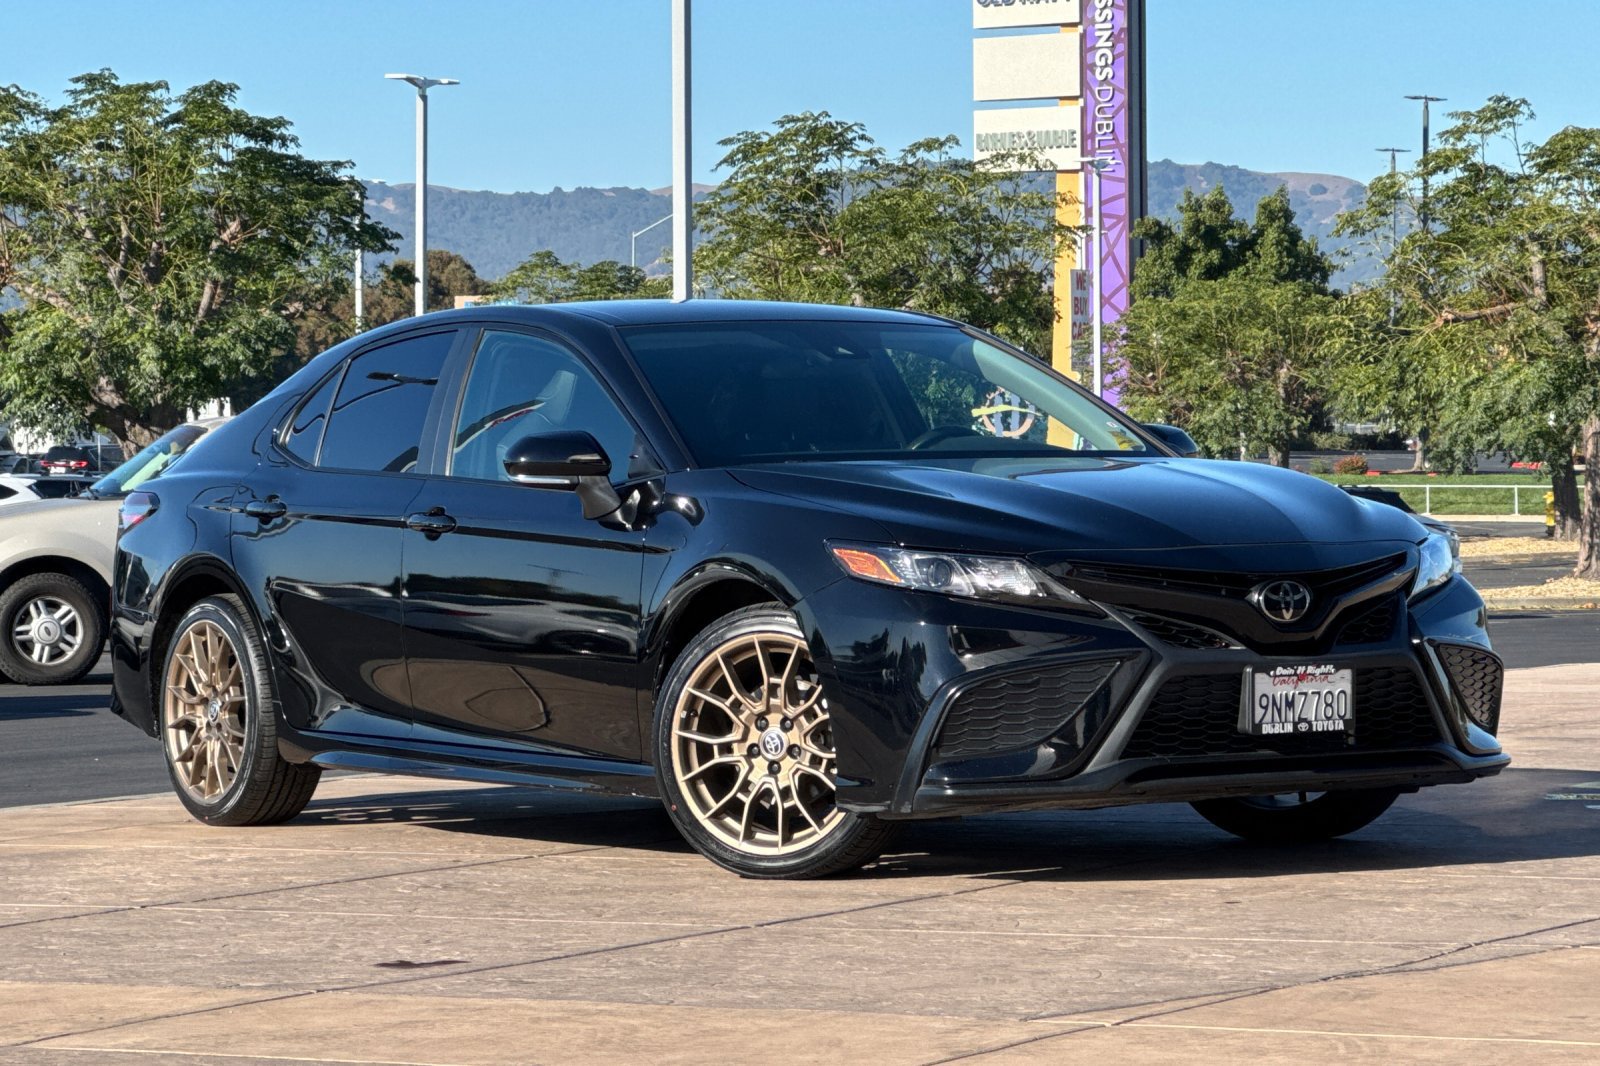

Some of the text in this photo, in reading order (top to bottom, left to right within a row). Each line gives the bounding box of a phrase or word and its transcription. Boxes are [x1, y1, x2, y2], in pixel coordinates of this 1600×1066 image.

[1095, 86, 1114, 173] DUBLIN
[1074, 297, 1088, 315] BUY
[1272, 675, 1328, 689] Califrnia
[1258, 689, 1347, 723] 9NMZ780
[1262, 720, 1344, 734] DUBLIN TOYOTA
